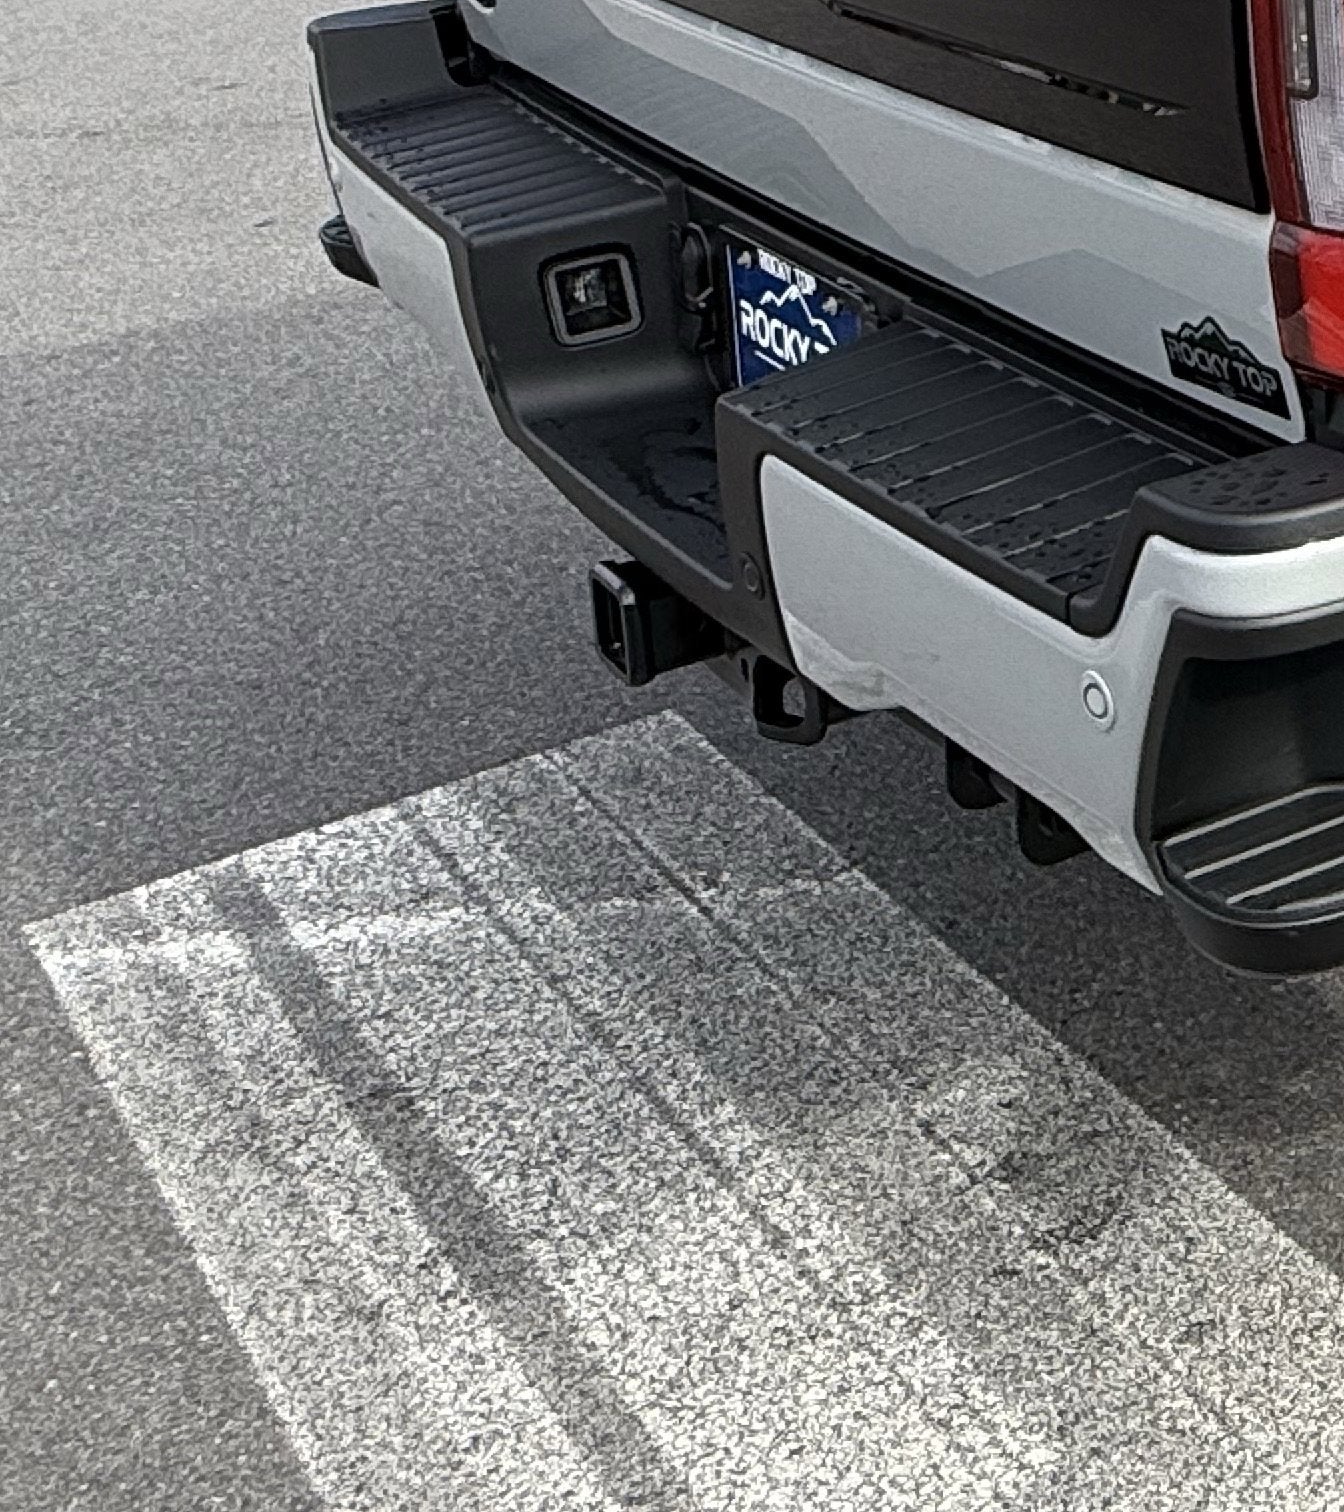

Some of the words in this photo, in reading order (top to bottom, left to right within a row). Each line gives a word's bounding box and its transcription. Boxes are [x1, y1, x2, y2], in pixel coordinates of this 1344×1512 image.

[738, 298, 811, 366] ROCKY
[1166, 337, 1230, 380] ROCKY
[1232, 360, 1278, 398] TOP
